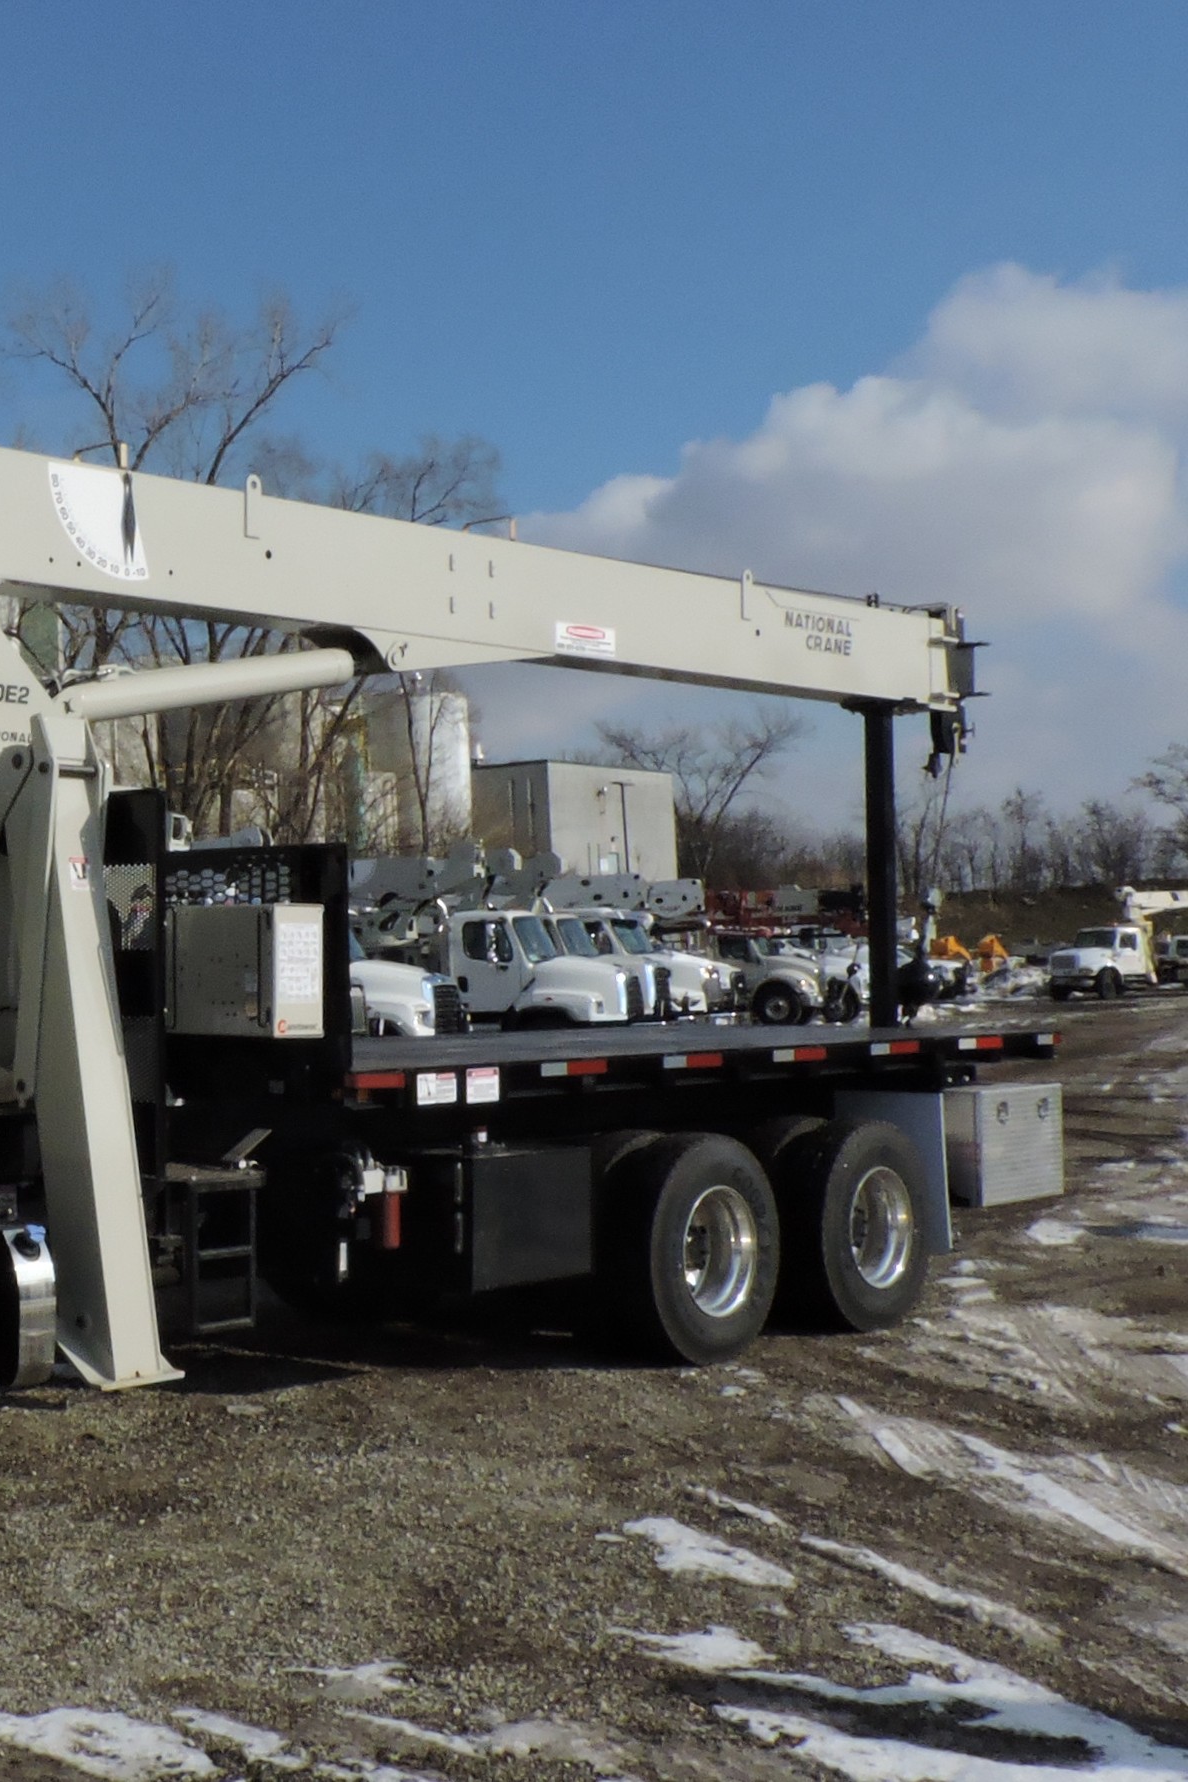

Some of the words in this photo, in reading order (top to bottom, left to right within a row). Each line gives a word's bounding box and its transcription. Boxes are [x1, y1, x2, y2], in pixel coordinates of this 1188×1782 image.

[54, 492, 63, 504] 70
[59, 507, 69, 520] 60
[76, 537, 85, 548] 40
[96, 557, 107, 568] 20
[110, 564, 119, 574] 10
[124, 567, 130, 577] 0
[132, 568, 145, 577] -10
[785, 611, 852, 637] NATIONAL
[806, 634, 851, 656] CRANE
